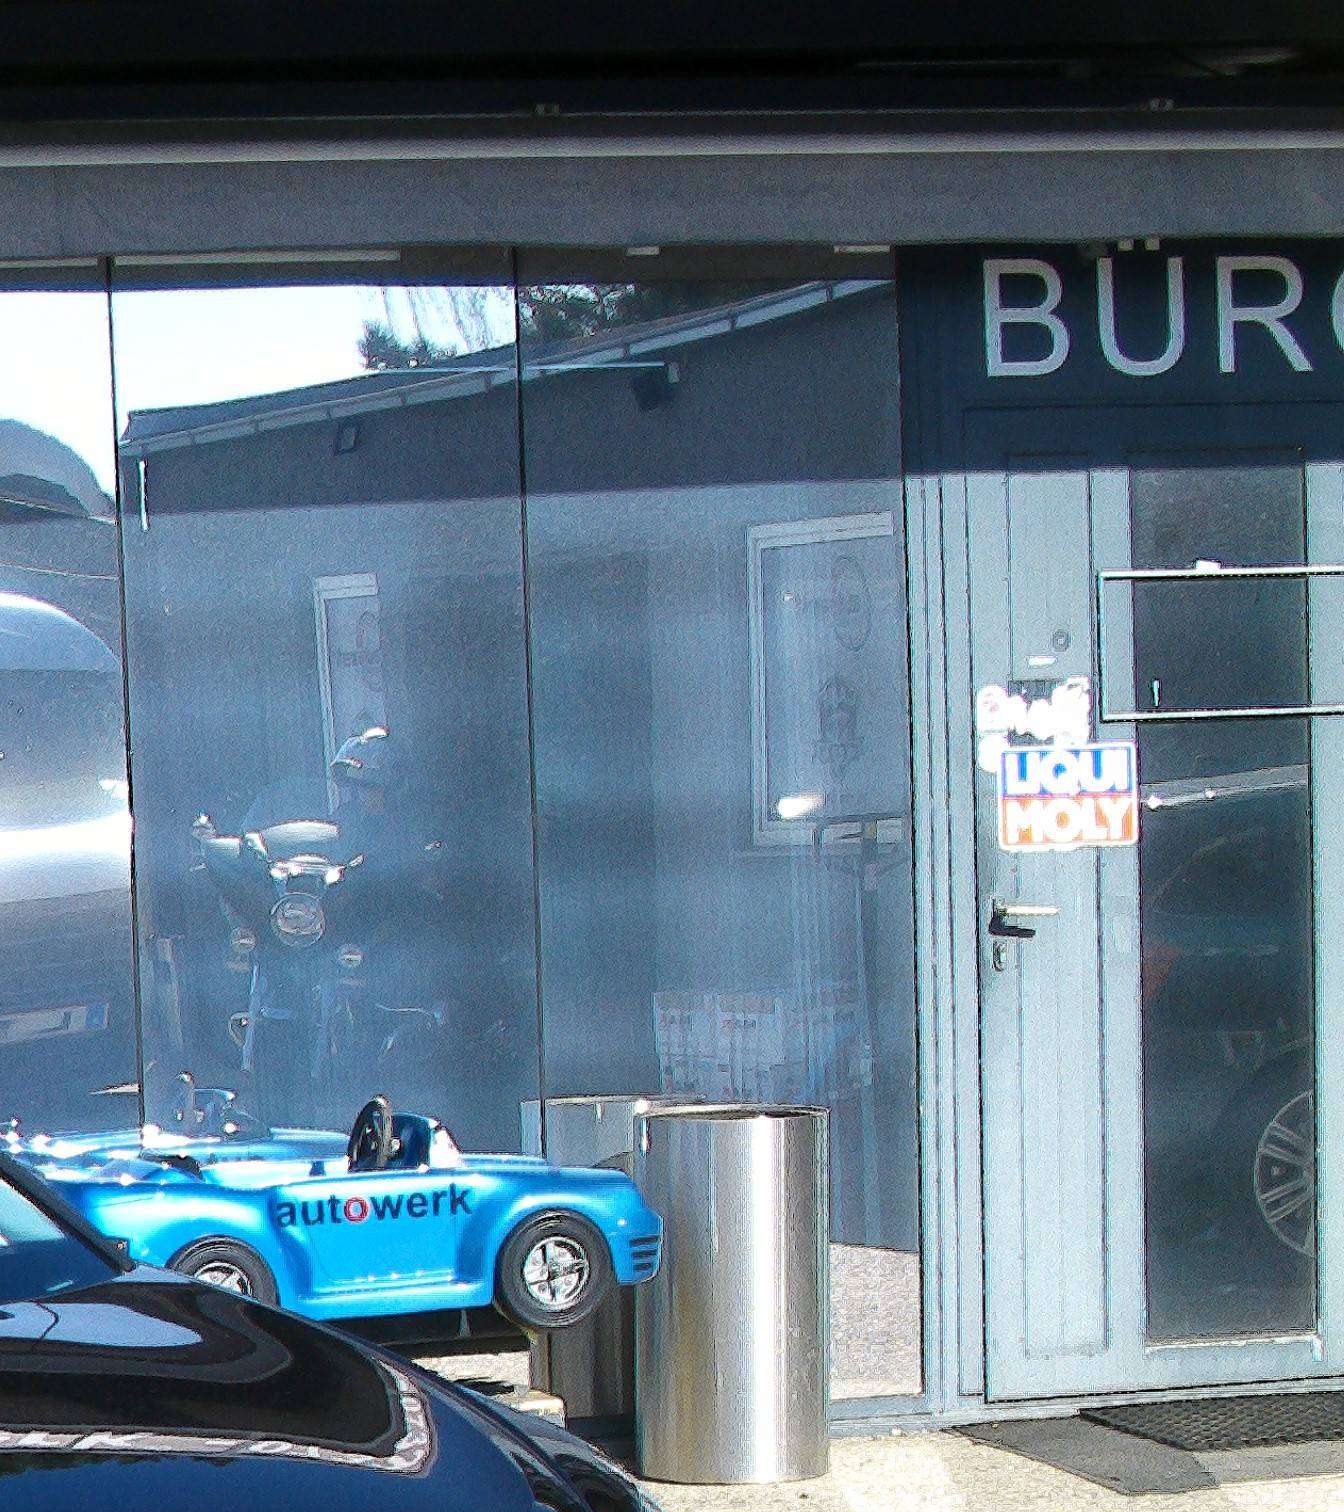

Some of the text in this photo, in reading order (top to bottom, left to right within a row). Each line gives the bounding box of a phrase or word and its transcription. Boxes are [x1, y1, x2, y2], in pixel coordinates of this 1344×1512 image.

[983, 238, 1344, 378] BÜR
[1005, 748, 1129, 796] LIQUI
[1006, 797, 1134, 844] MOLY
[276, 1182, 472, 1228] autowerk
